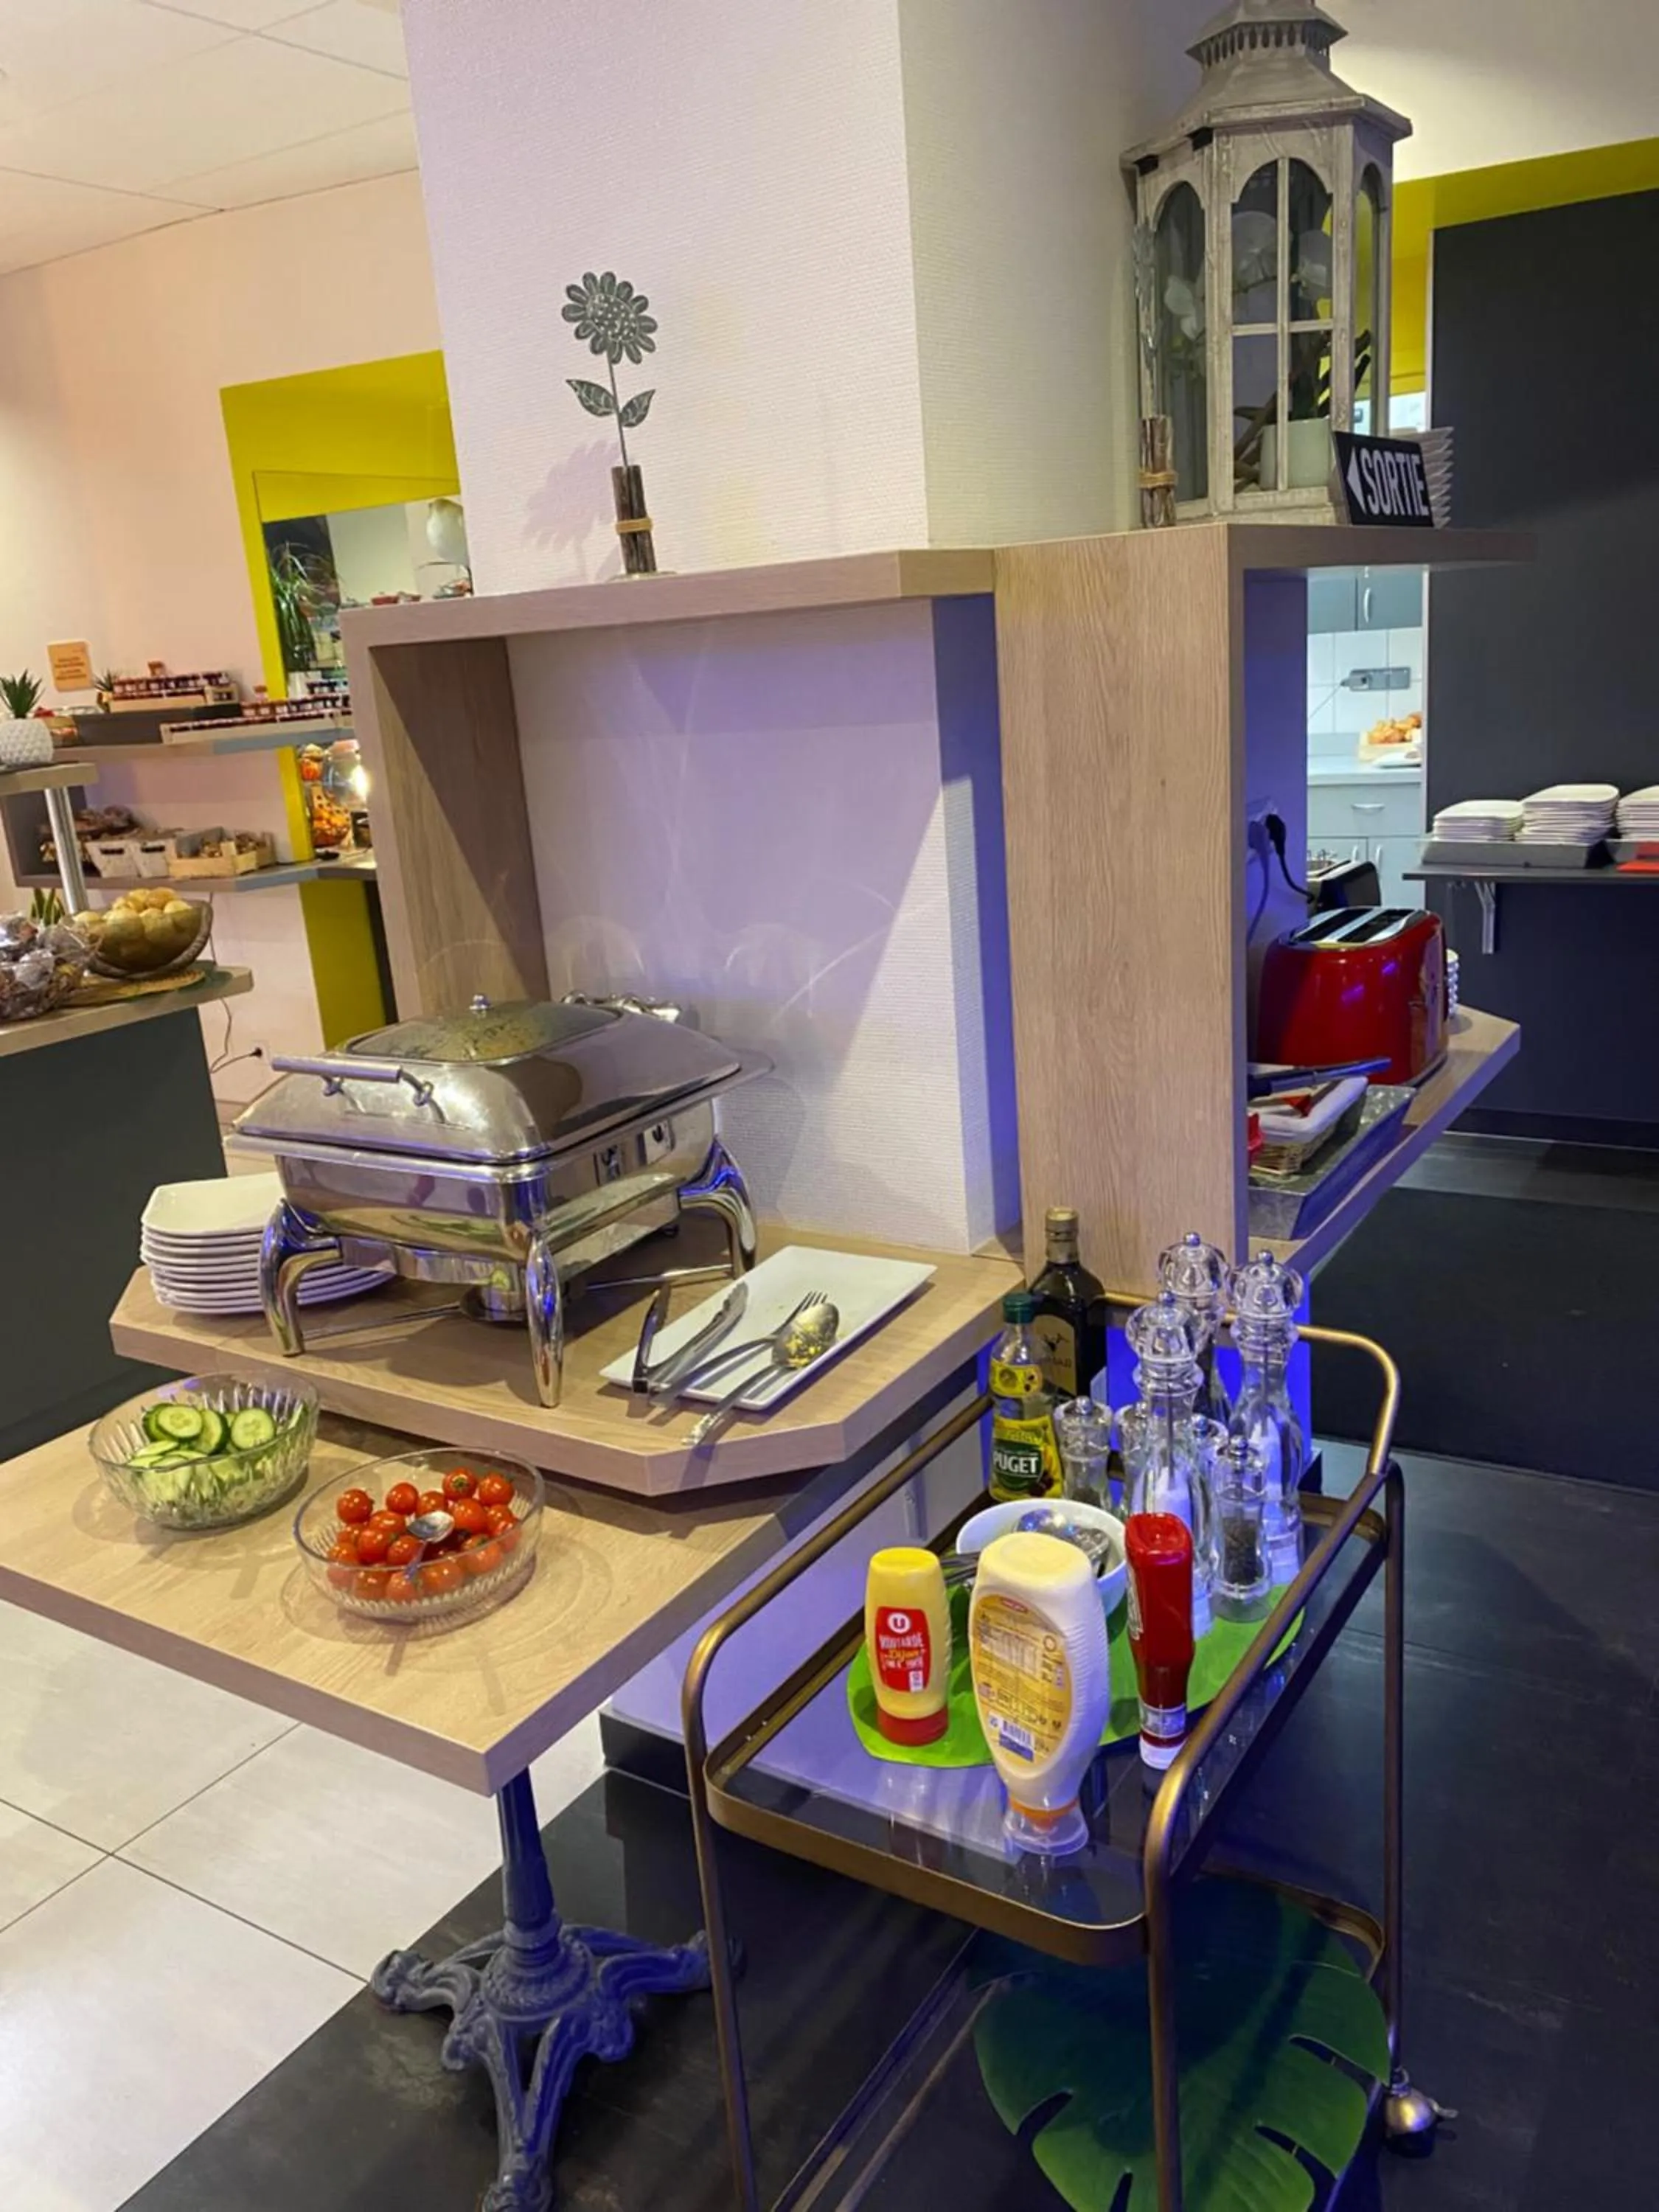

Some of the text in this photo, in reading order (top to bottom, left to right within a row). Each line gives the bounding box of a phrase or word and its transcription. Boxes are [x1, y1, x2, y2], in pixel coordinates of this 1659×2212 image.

[1360, 448, 1430, 515] SORTIE
[992, 1450, 1039, 1474] PUGET
[893, 1617, 906, 1630] U
